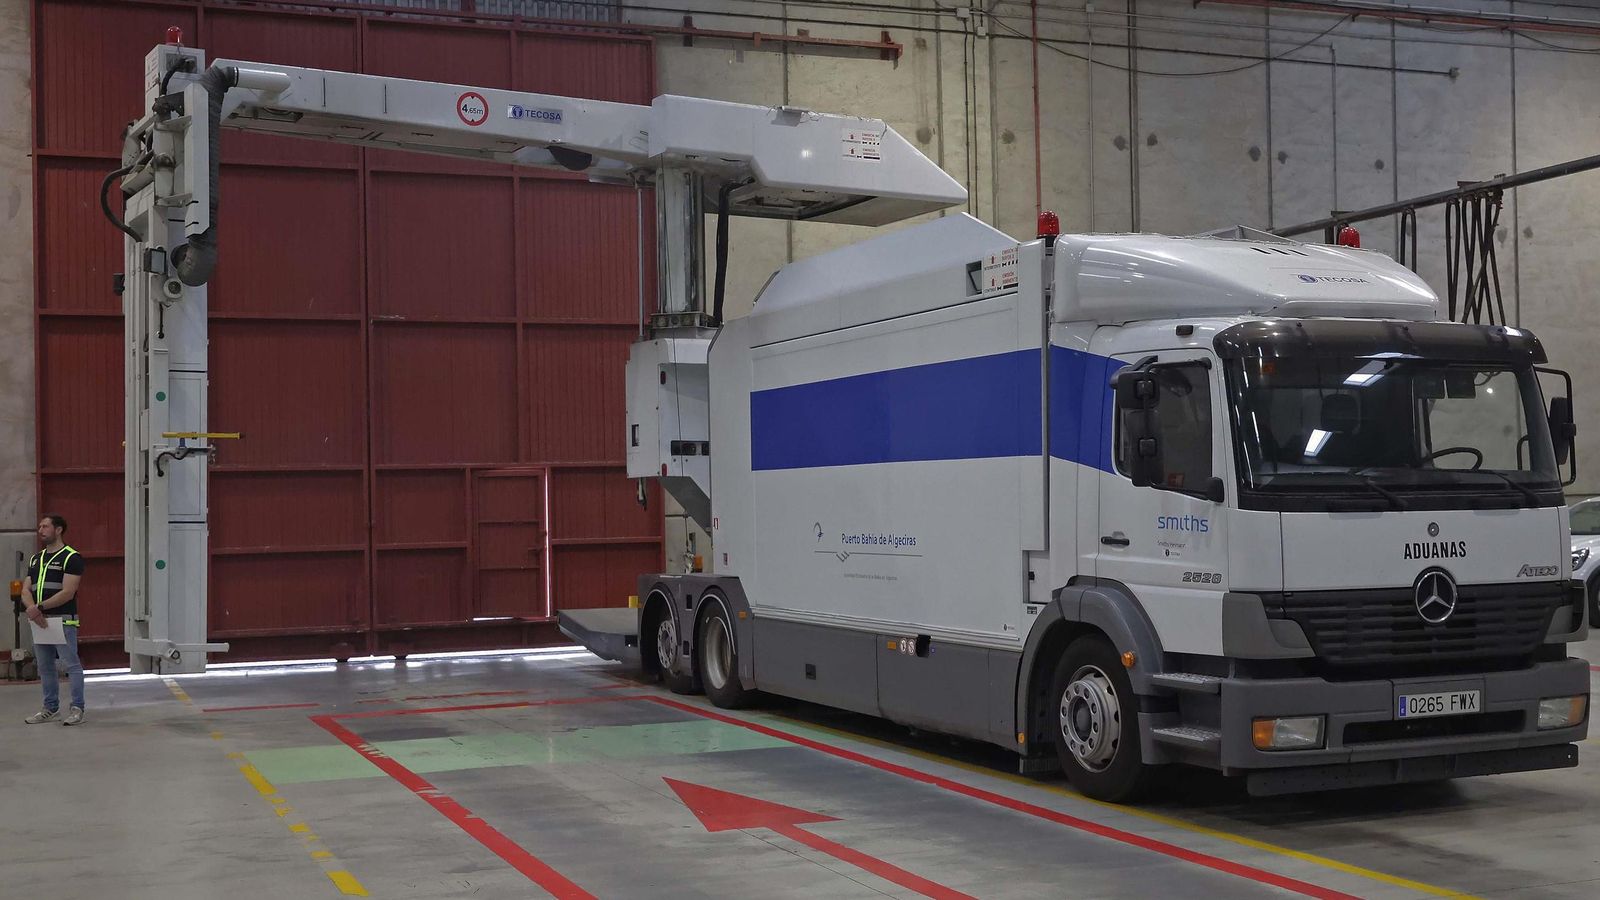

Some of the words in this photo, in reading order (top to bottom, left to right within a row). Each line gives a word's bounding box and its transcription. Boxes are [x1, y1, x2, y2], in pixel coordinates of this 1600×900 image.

[525, 109, 562, 121] TECOSA
[1316, 276, 1370, 284] TECOSA
[1157, 514, 1209, 532] smiths
[841, 533, 861, 545] Puerto
[879, 533, 887, 545] de
[888, 534, 917, 548] Algeciras
[1403, 540, 1467, 559] ADUANAS
[1182, 571, 1222, 584] 2528
[1410, 696, 1444, 713] 0265
[1450, 693, 1475, 711] FWX
